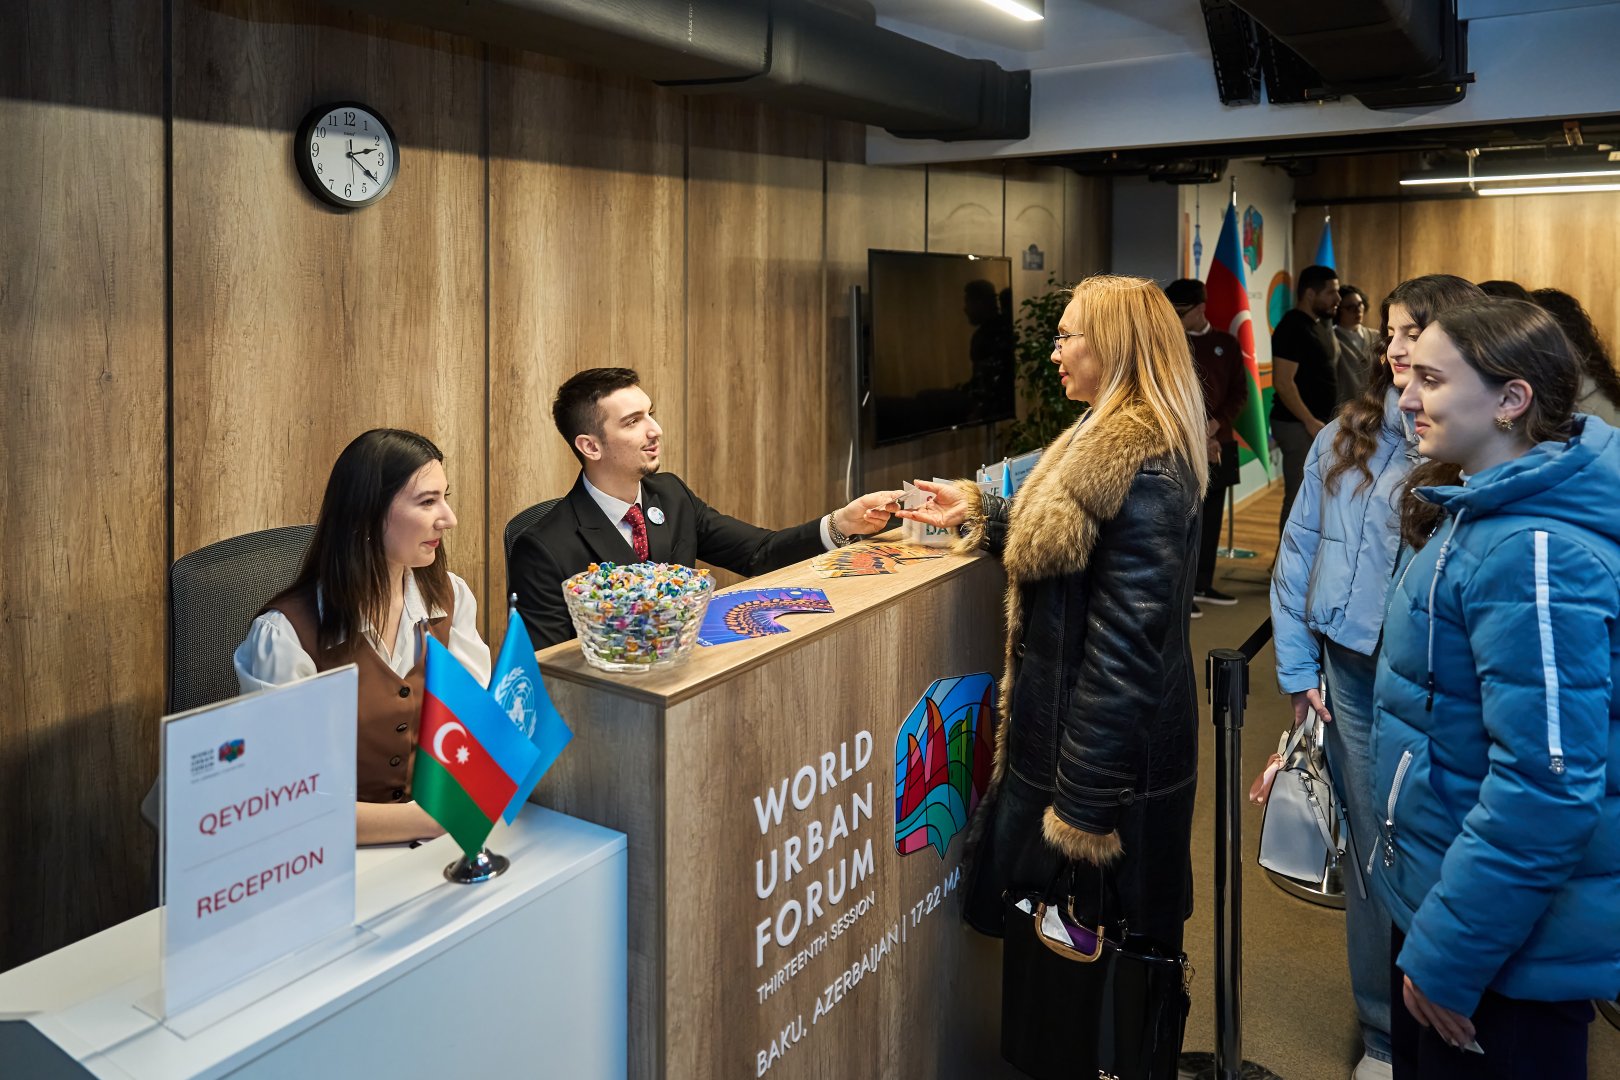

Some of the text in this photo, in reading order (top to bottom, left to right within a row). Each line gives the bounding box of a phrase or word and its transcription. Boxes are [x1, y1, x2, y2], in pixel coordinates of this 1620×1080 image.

[328, 115, 338, 126] 11
[343, 112, 356, 127] 12
[363, 120, 368, 131] 1
[315, 127, 326, 138] 10
[374, 135, 380, 146] 2
[311, 142, 320, 157] 9
[377, 152, 384, 166] 3
[317, 163, 323, 174] 8
[328, 179, 334, 190] 7
[344, 183, 352, 198] 6
[361, 182, 367, 193] 5
[753, 730, 873, 835] WORLD
[199, 773, 320, 836] QEYDİYYAT
[756, 782, 873, 899] URBAN
[197, 847, 324, 919] RECEPTION
[756, 838, 875, 968] FORUM
[757, 891, 875, 1005] THIRTEENTH SESSION
[757, 1015, 807, 1078] BAKU,
[812, 924, 898, 1025] AZERBAIJAN
[911, 885, 941, 927] 17-22
[944, 866, 960, 897] MA
